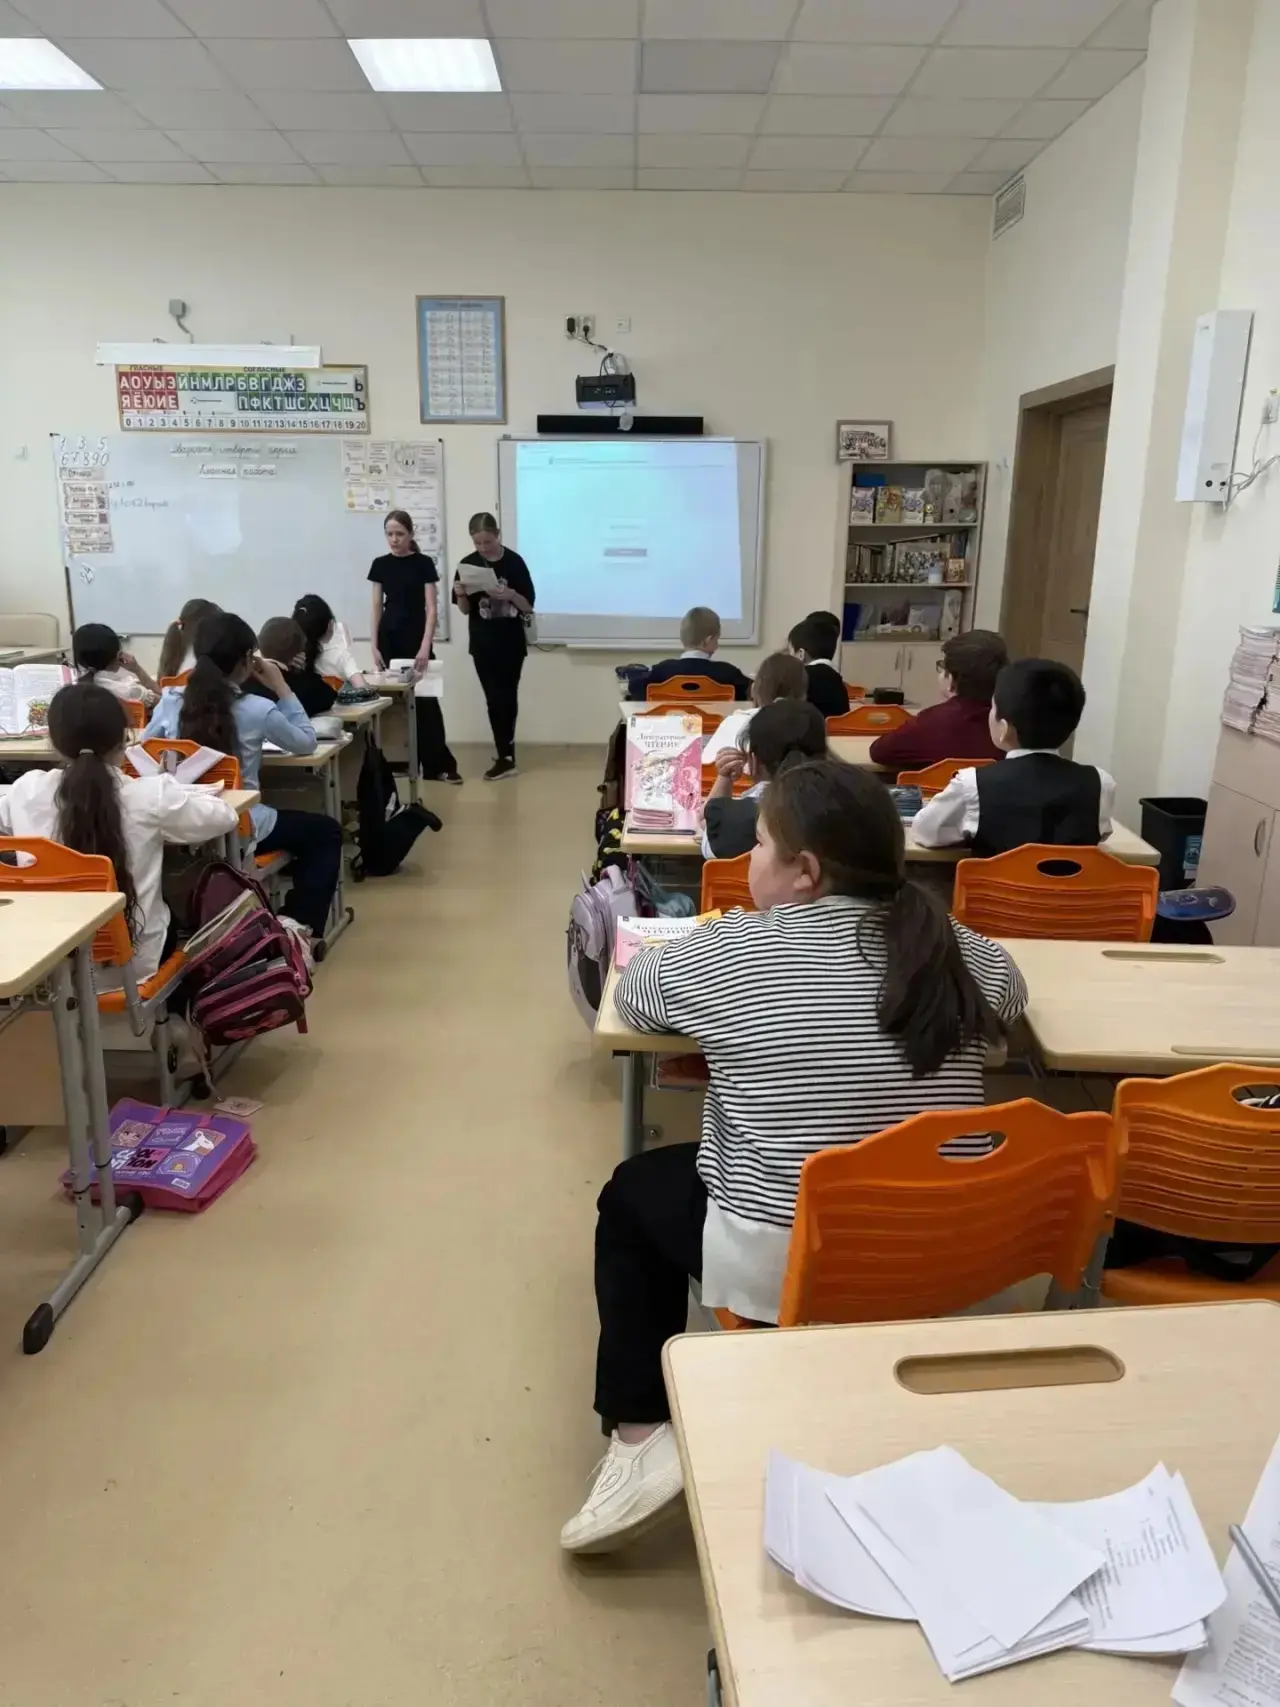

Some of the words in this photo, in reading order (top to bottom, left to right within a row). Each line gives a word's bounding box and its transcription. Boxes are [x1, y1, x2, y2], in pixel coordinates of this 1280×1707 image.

[126, 418, 131, 426] 0
[138, 419, 142, 427] 1
[149, 419, 154, 427] 2
[161, 419, 166, 427] 3
[172, 419, 178, 427] 4
[184, 419, 189, 427] 5
[196, 419, 200, 427] 6
[207, 419, 212, 427] 7
[219, 419, 224, 427] 8
[231, 420, 236, 428] 9
[240, 420, 249, 428] 10
[253, 420, 260, 428] 11
[263, 420, 272, 428] 12
[275, 420, 284, 428] 13
[287, 420, 296, 428] 14
[299, 420, 308, 428] 15
[311, 420, 319, 428] 16
[321, 421, 330, 429] 17
[334, 421, 342, 429] 18
[345, 421, 354, 429] 19
[356, 421, 366, 429] 20
